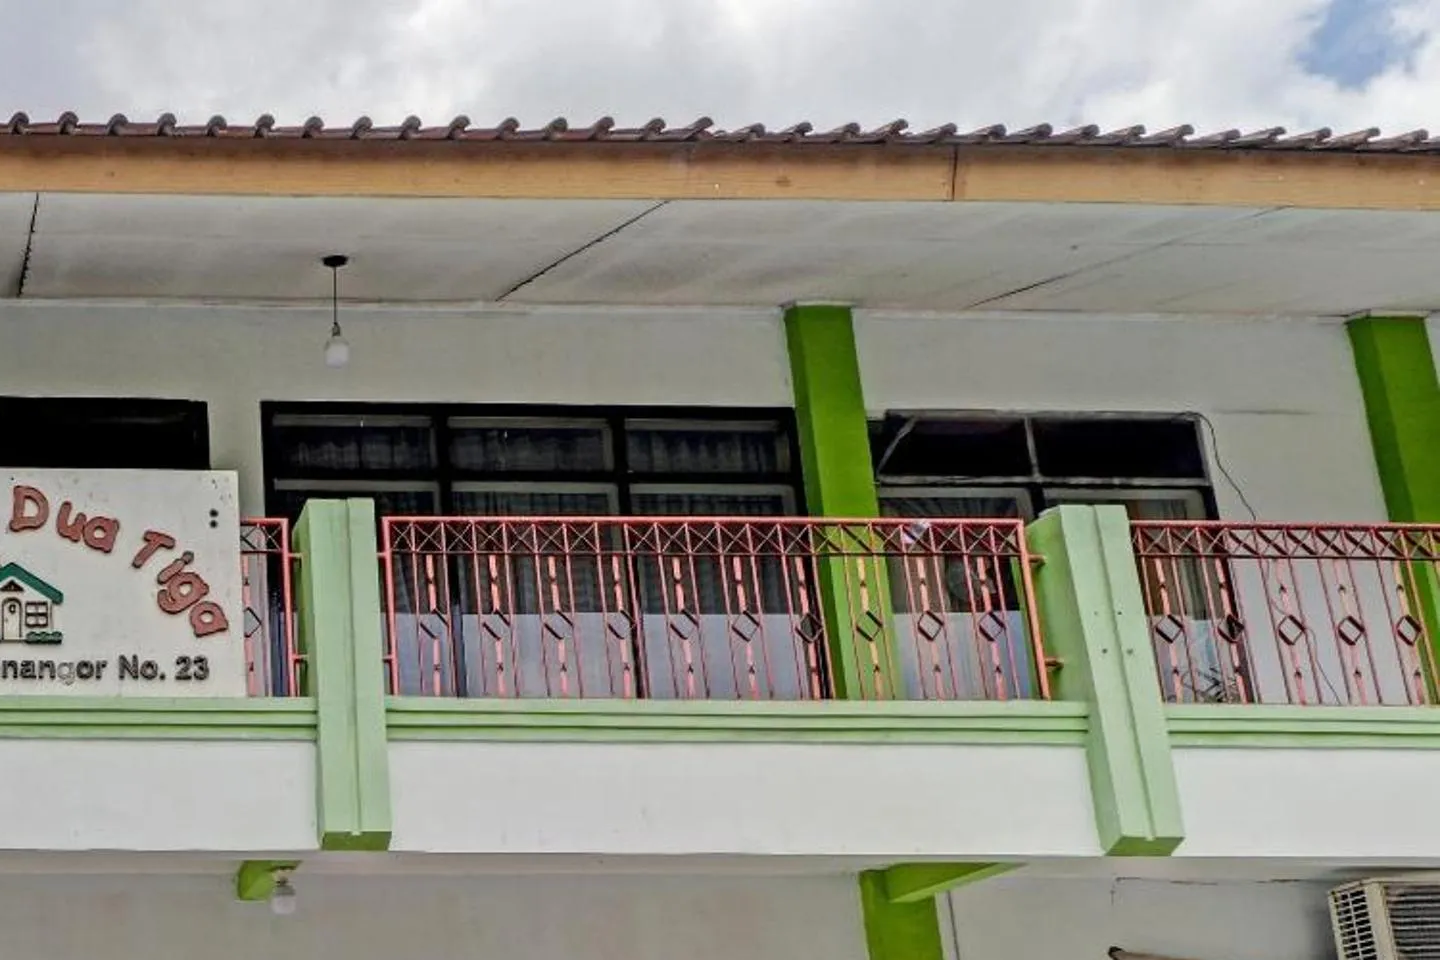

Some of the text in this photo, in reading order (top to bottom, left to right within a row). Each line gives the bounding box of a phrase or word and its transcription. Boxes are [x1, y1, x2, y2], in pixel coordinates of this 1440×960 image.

[9, 485, 121, 554] Dua
[132, 530, 230, 638] Tiga
[118, 655, 166, 682] No.
[175, 656, 210, 682] 23
